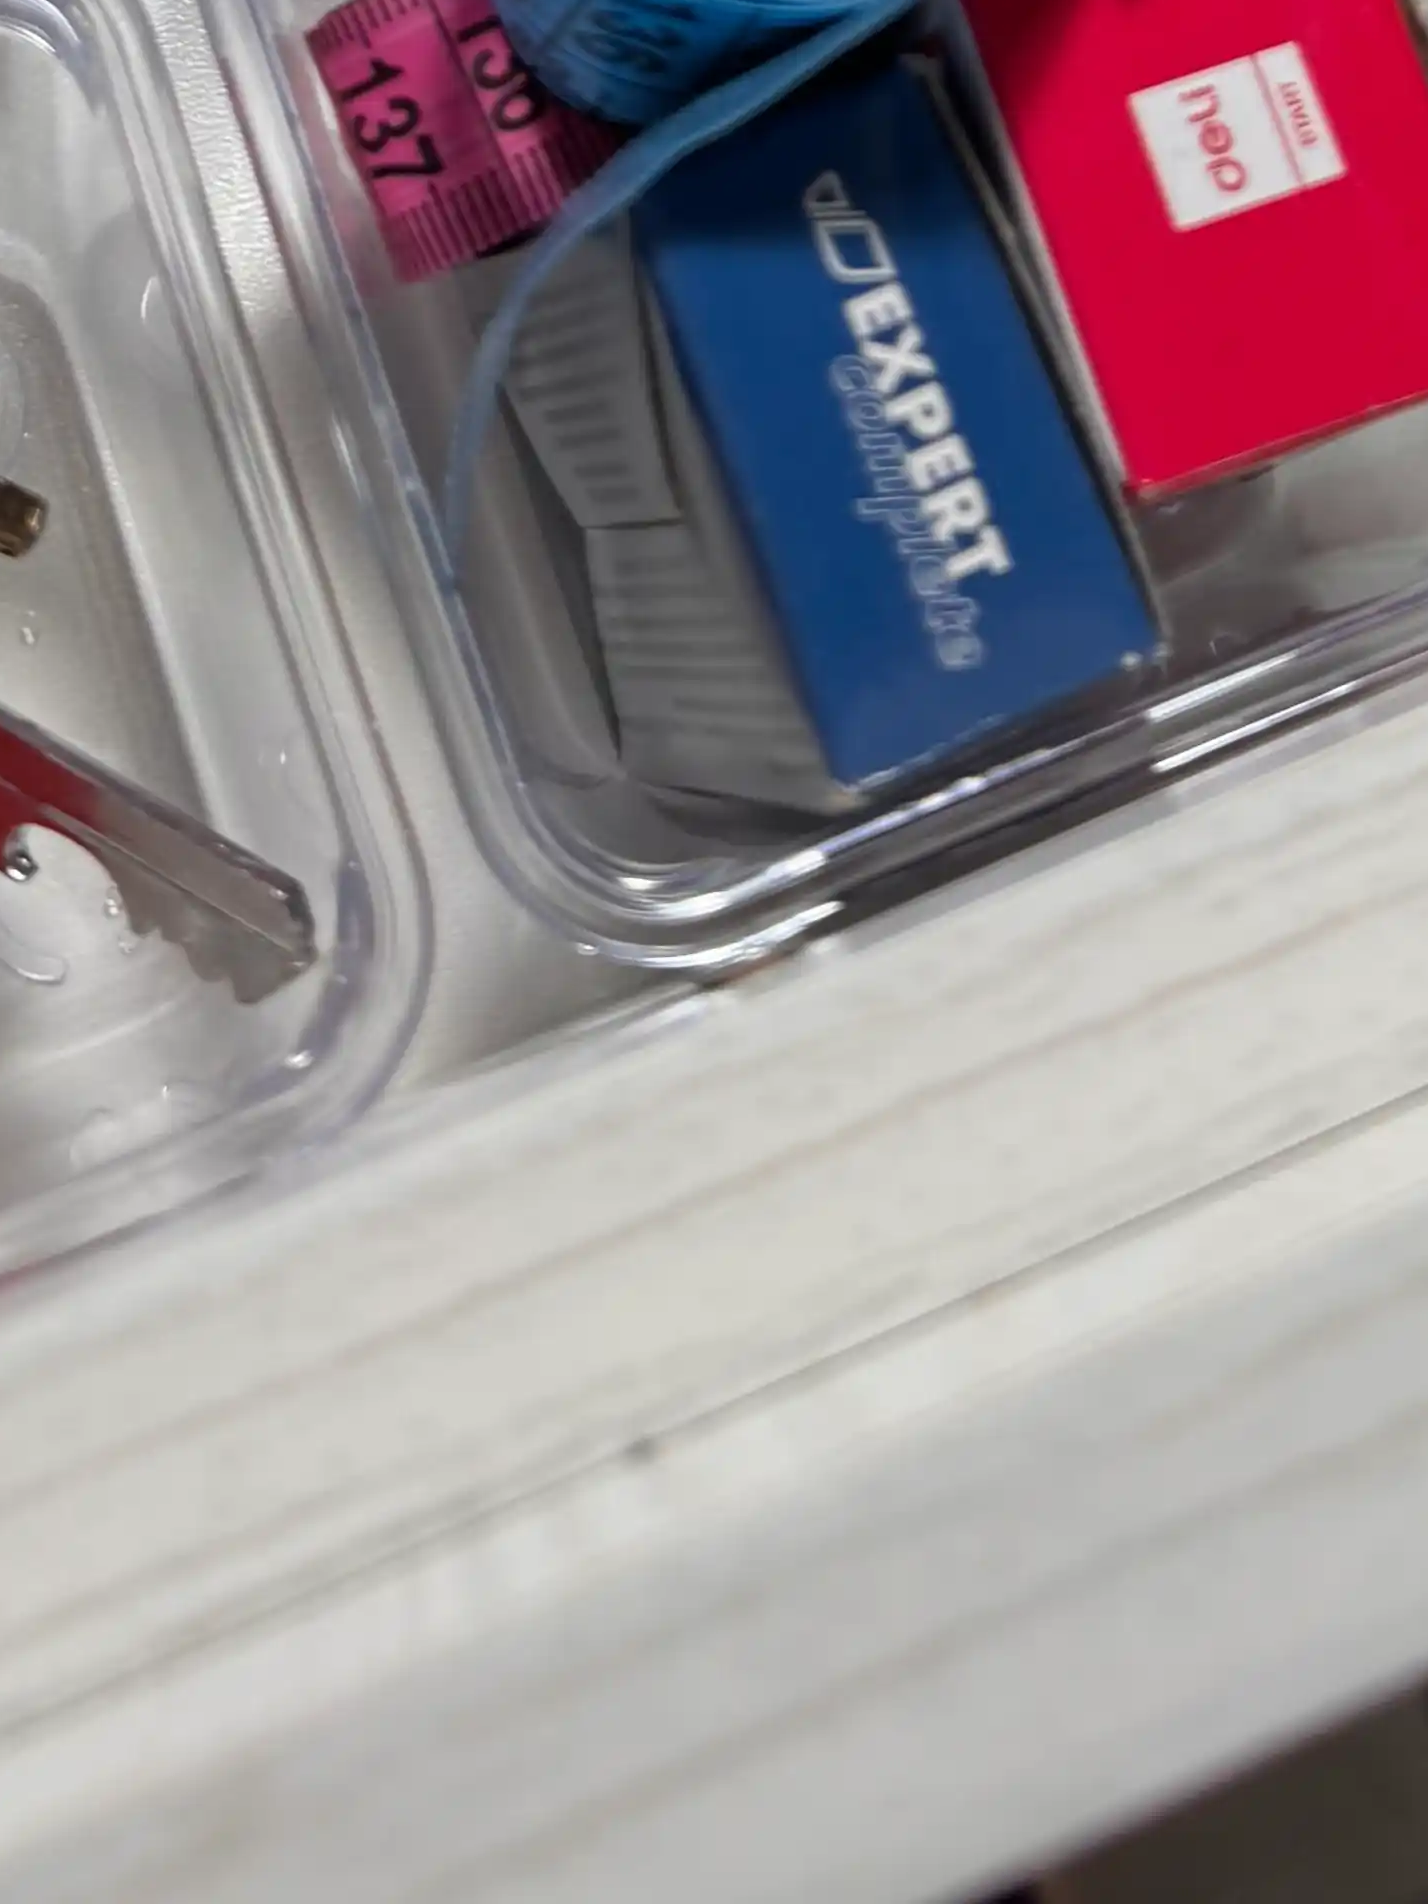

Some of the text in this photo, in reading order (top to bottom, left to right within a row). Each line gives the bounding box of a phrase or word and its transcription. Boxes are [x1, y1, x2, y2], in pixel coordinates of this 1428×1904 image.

[342, 58, 447, 178] 137
[1176, 84, 1247, 194] deli
[845, 280, 1014, 582] EXPERT
